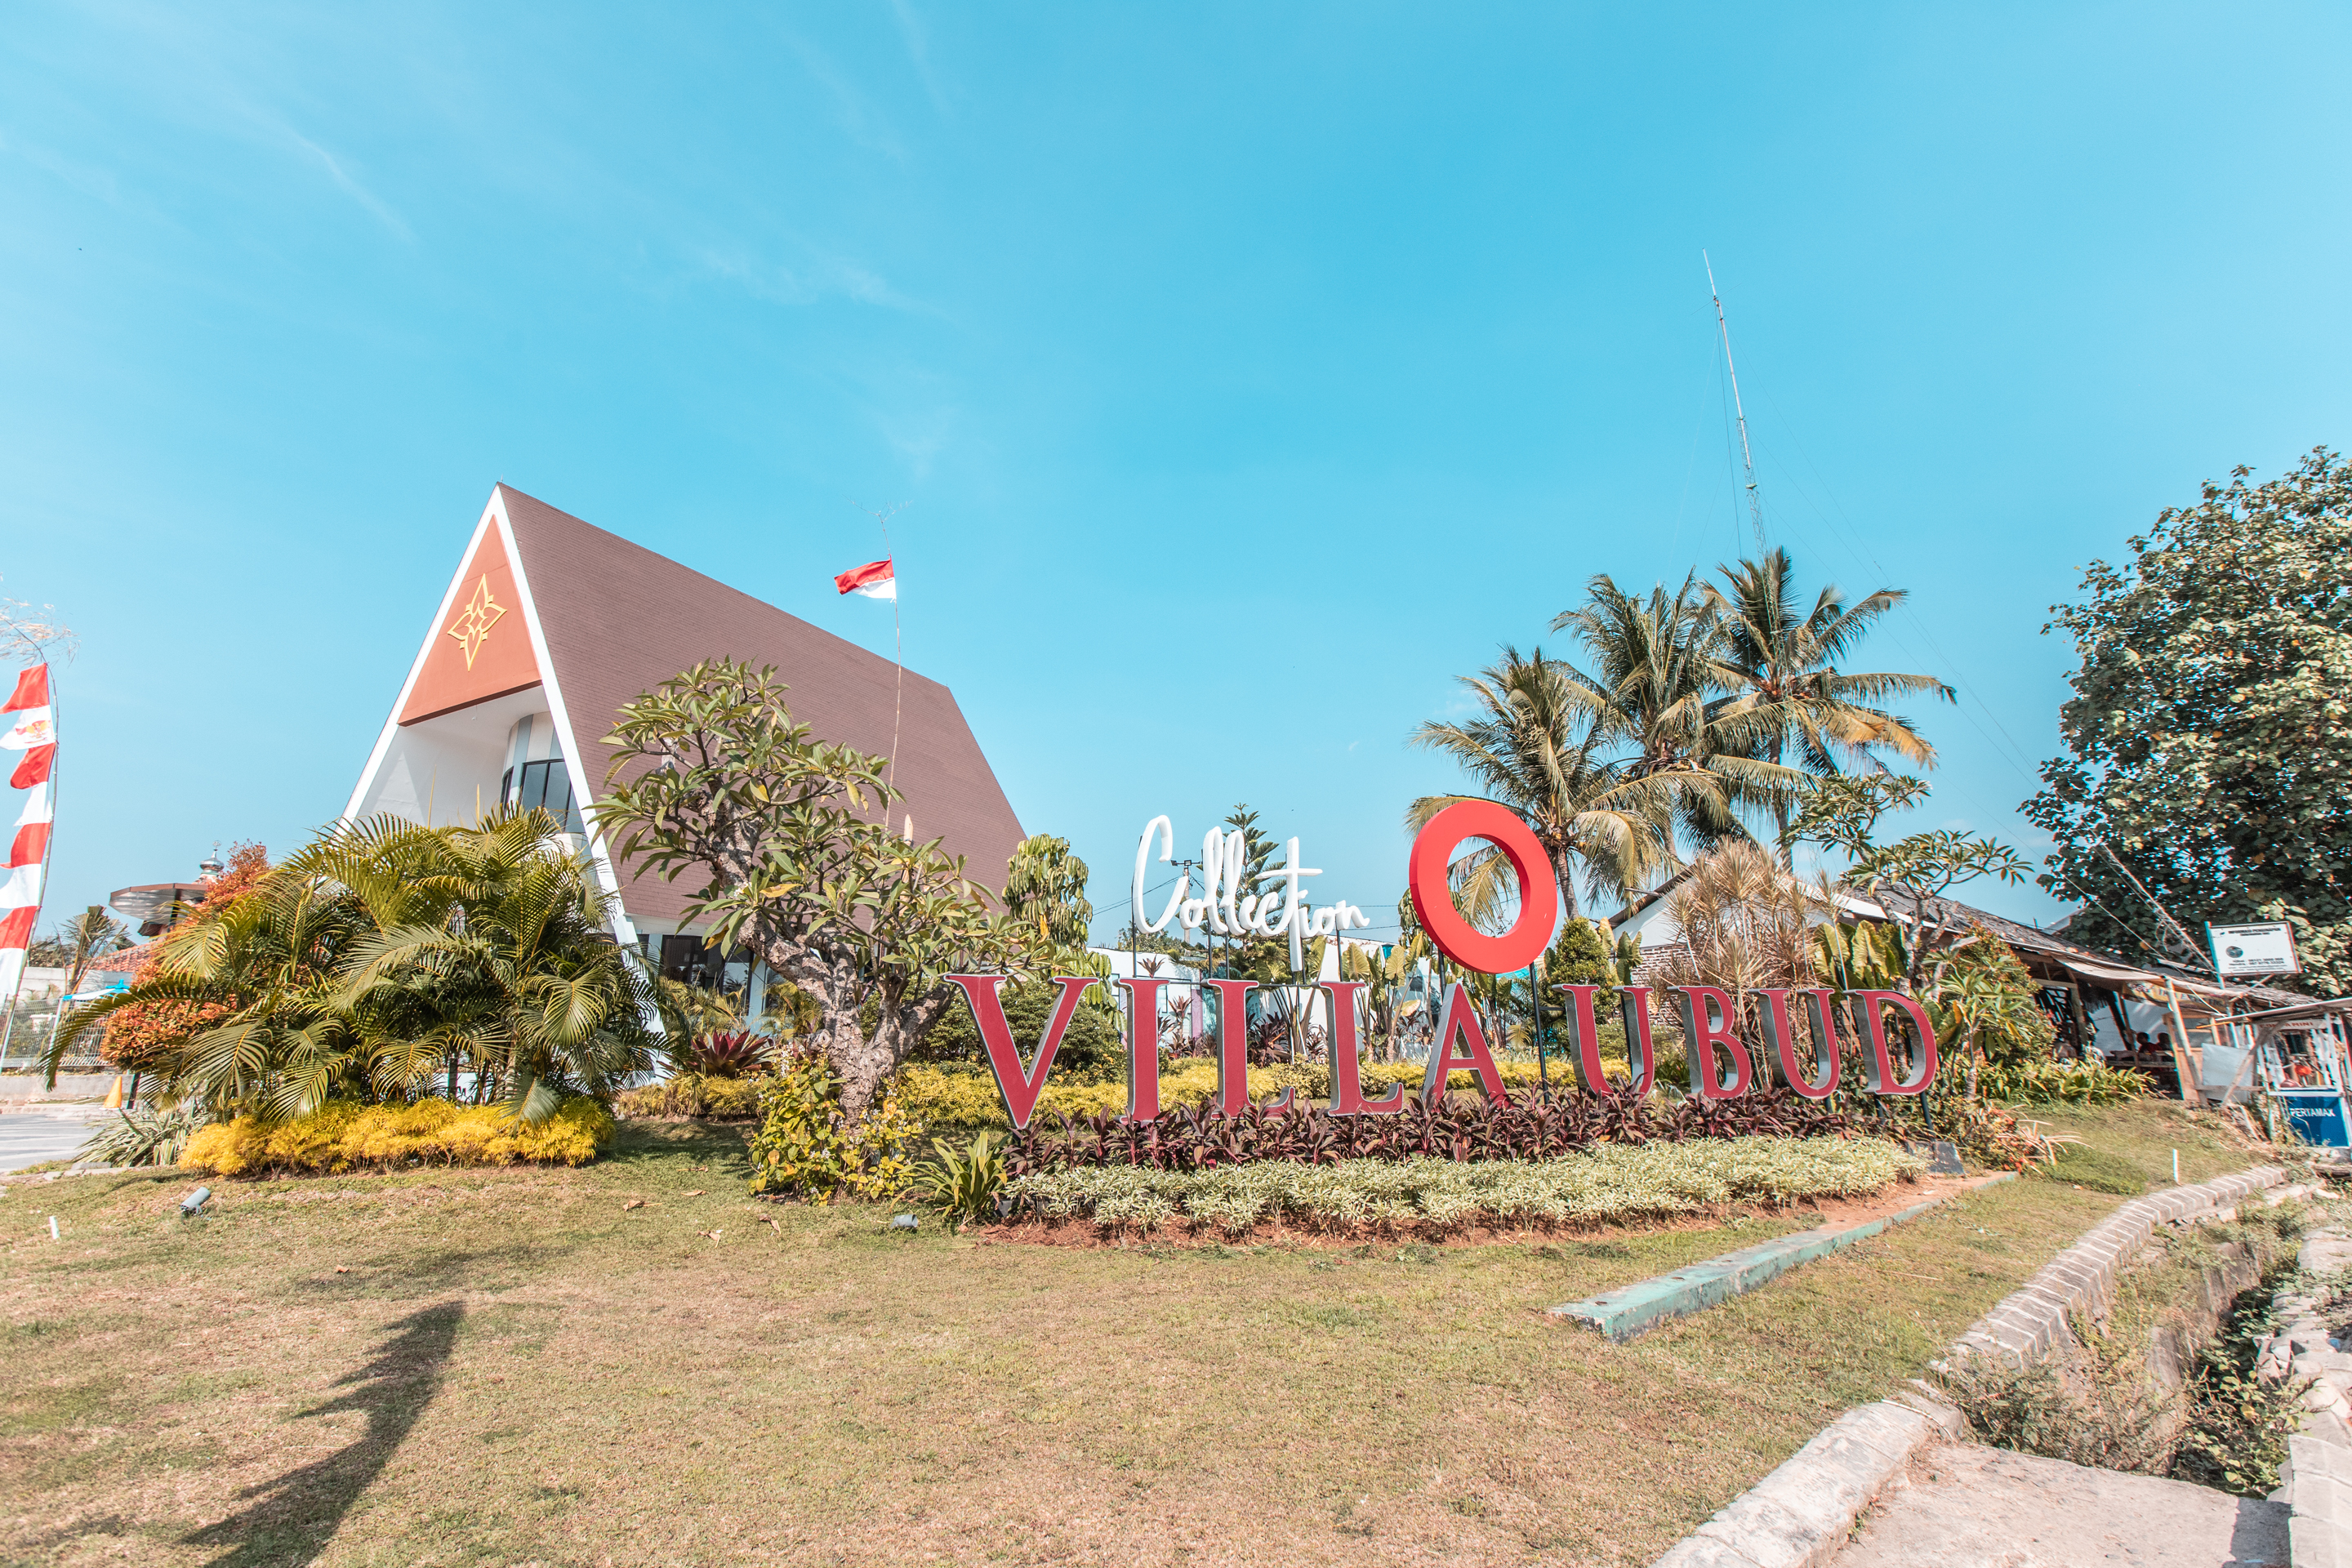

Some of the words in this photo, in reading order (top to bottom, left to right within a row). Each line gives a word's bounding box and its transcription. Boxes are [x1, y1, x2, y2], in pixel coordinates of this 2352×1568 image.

[1133, 814, 1370, 972] Collection
[943, 973, 1508, 1129] VILLA
[1552, 984, 1938, 1100] UBUD
[2289, 1107, 2336, 1117] PERTAMAX
